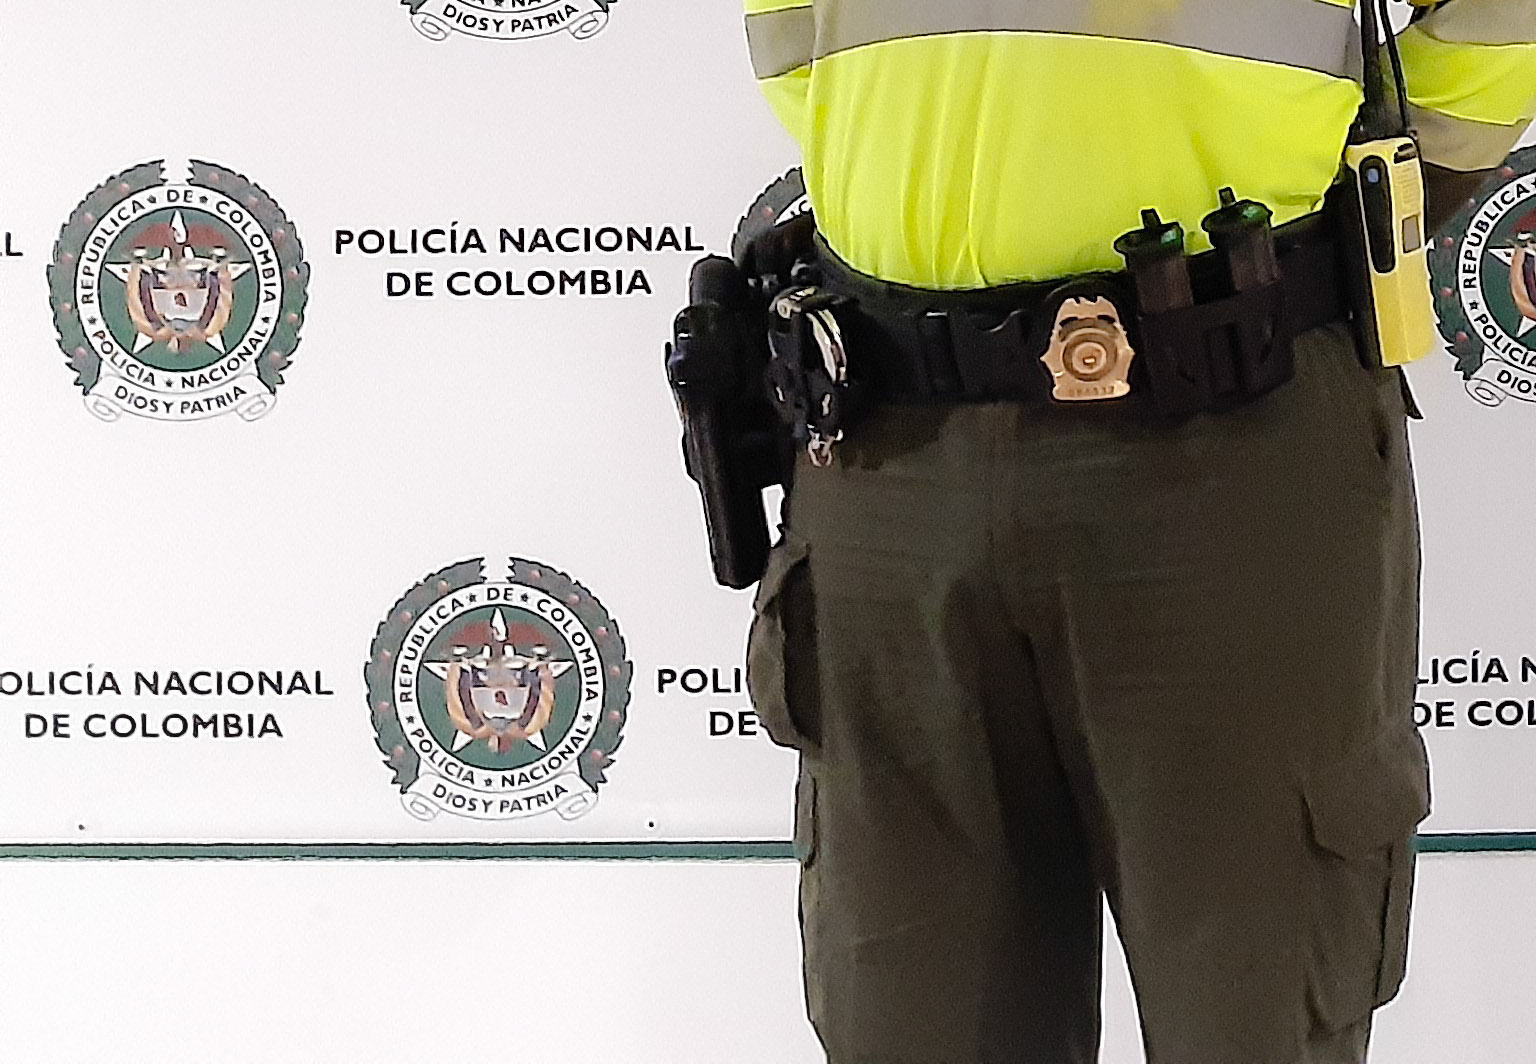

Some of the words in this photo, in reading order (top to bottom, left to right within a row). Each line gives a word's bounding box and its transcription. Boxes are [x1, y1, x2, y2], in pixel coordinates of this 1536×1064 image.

[336, 221, 487, 254] POLICÍA
[500, 226, 705, 254] NACIONAL
[387, 272, 434, 296] DE
[447, 270, 651, 296] COLOMBIA
[0, 664, 121, 696] OLICÍA
[135, 671, 334, 696] NACIONAL
[658, 667, 741, 694] POLI
[25, 713, 70, 738] DE
[84, 713, 283, 738] COLOMBIA
[710, 711, 757, 737] DE
